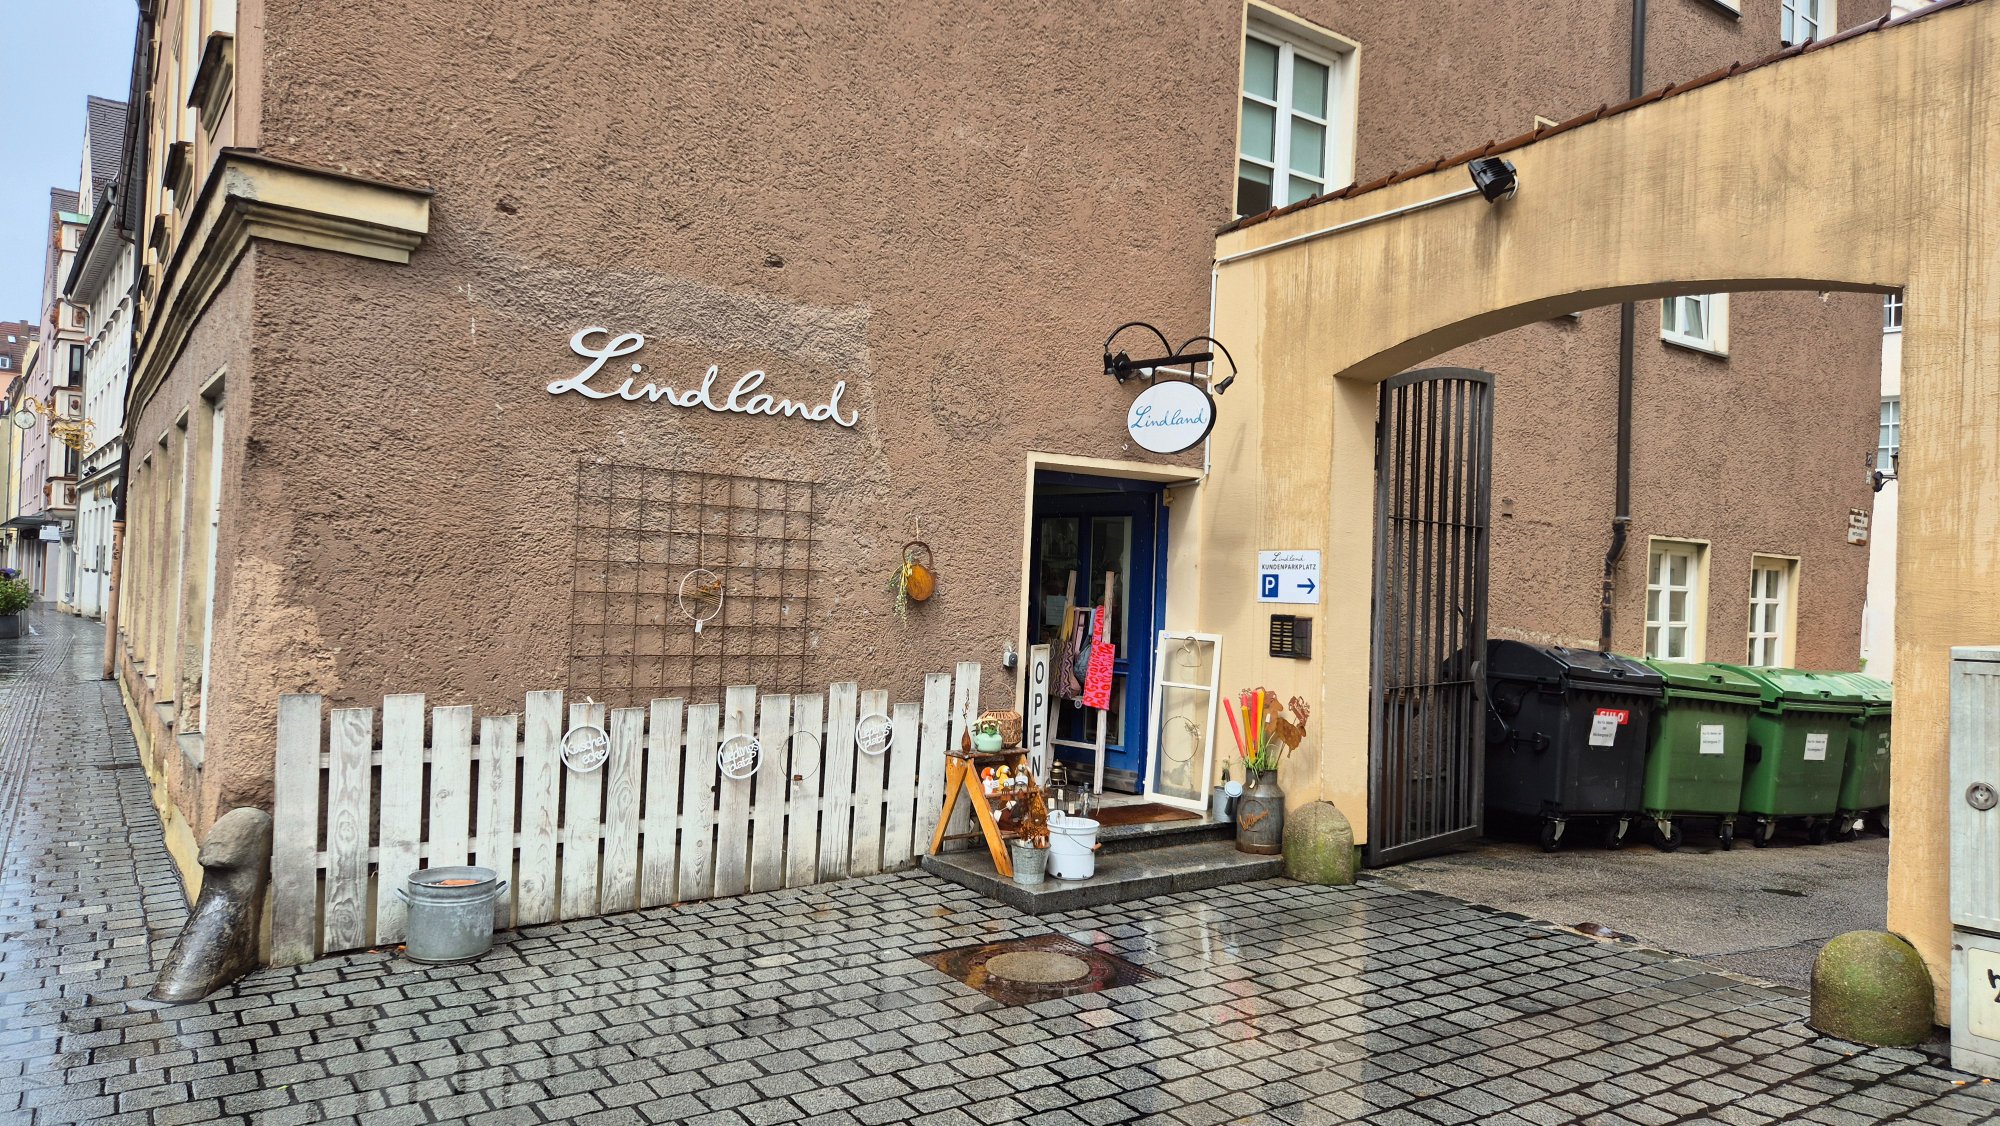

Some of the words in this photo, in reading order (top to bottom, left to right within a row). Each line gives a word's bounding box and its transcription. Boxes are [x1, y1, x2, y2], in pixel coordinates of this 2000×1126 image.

[546, 327, 858, 427] Lindland
[1131, 406, 1206, 428] Lindland
[1265, 576, 1275, 595] P
[1032, 661, 1044, 777] OPEN
